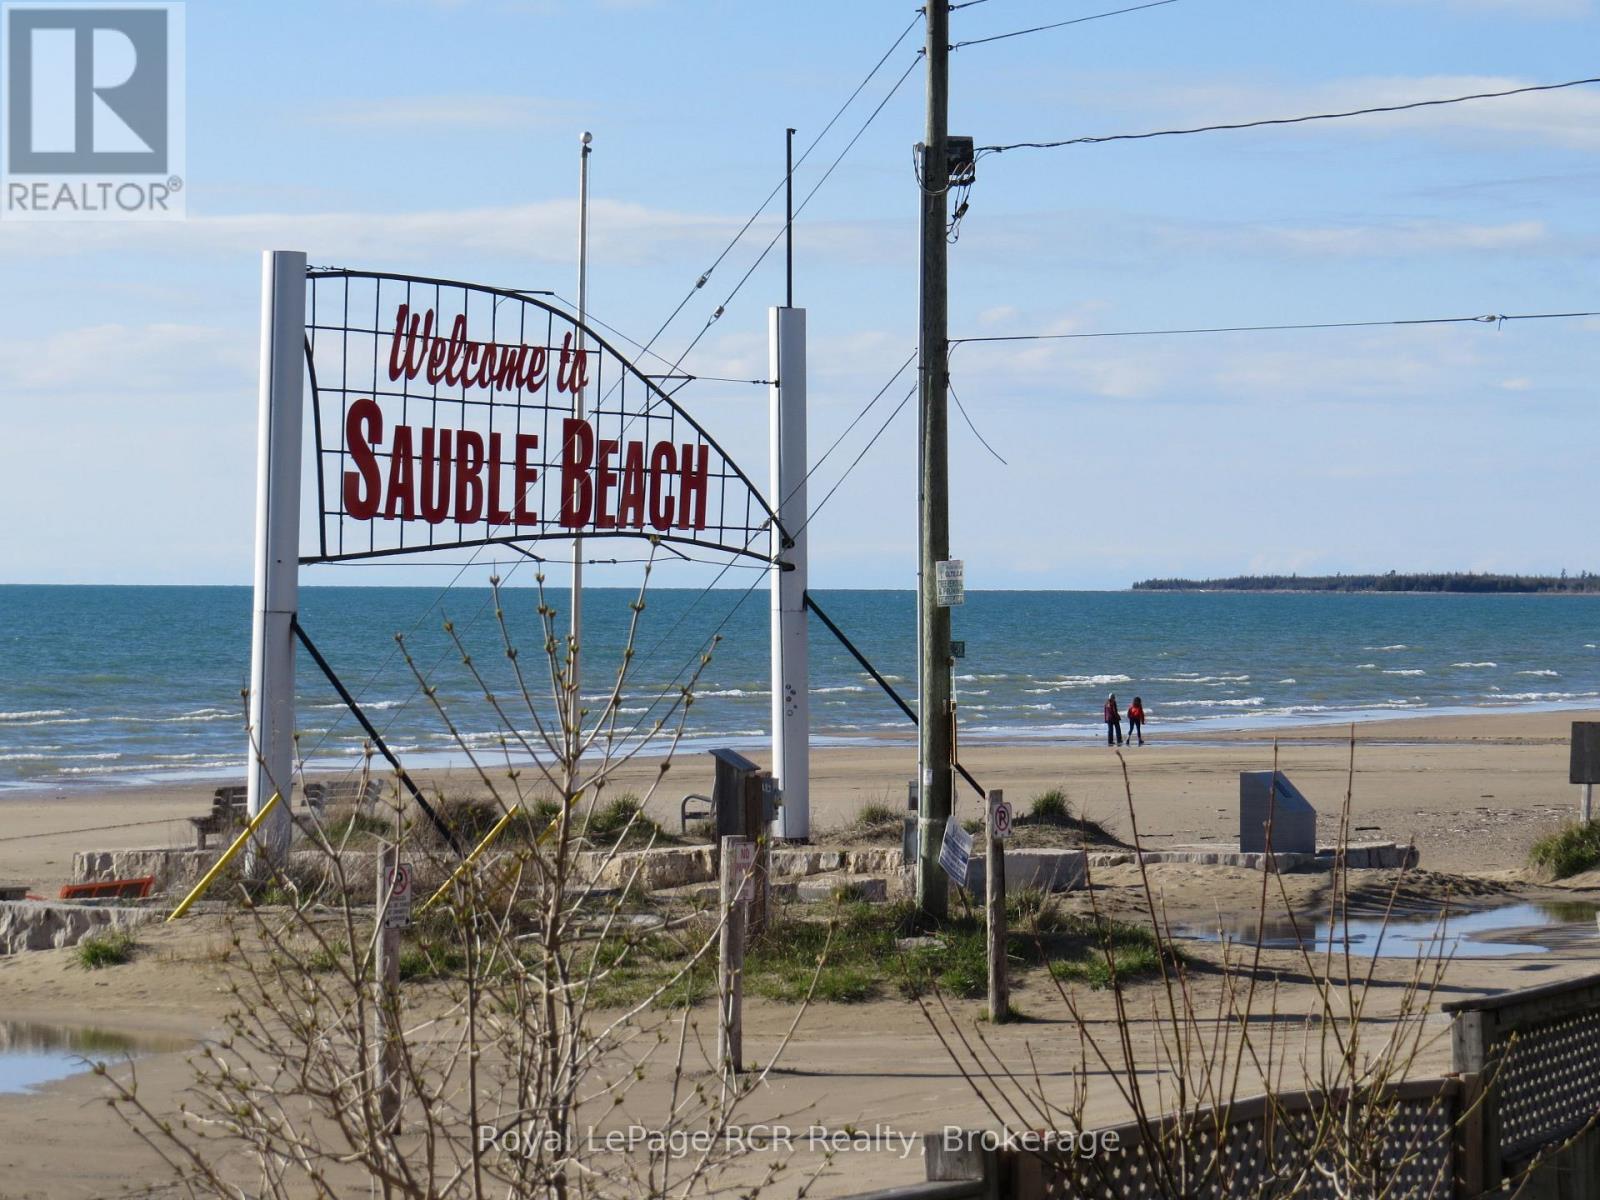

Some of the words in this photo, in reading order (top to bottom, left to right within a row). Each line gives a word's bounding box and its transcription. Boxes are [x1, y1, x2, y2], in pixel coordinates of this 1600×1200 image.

[388, 304, 548, 393] Welcome
[557, 331, 588, 394] to
[343, 398, 539, 526] SAUBLE
[559, 418, 709, 531] BEACH
